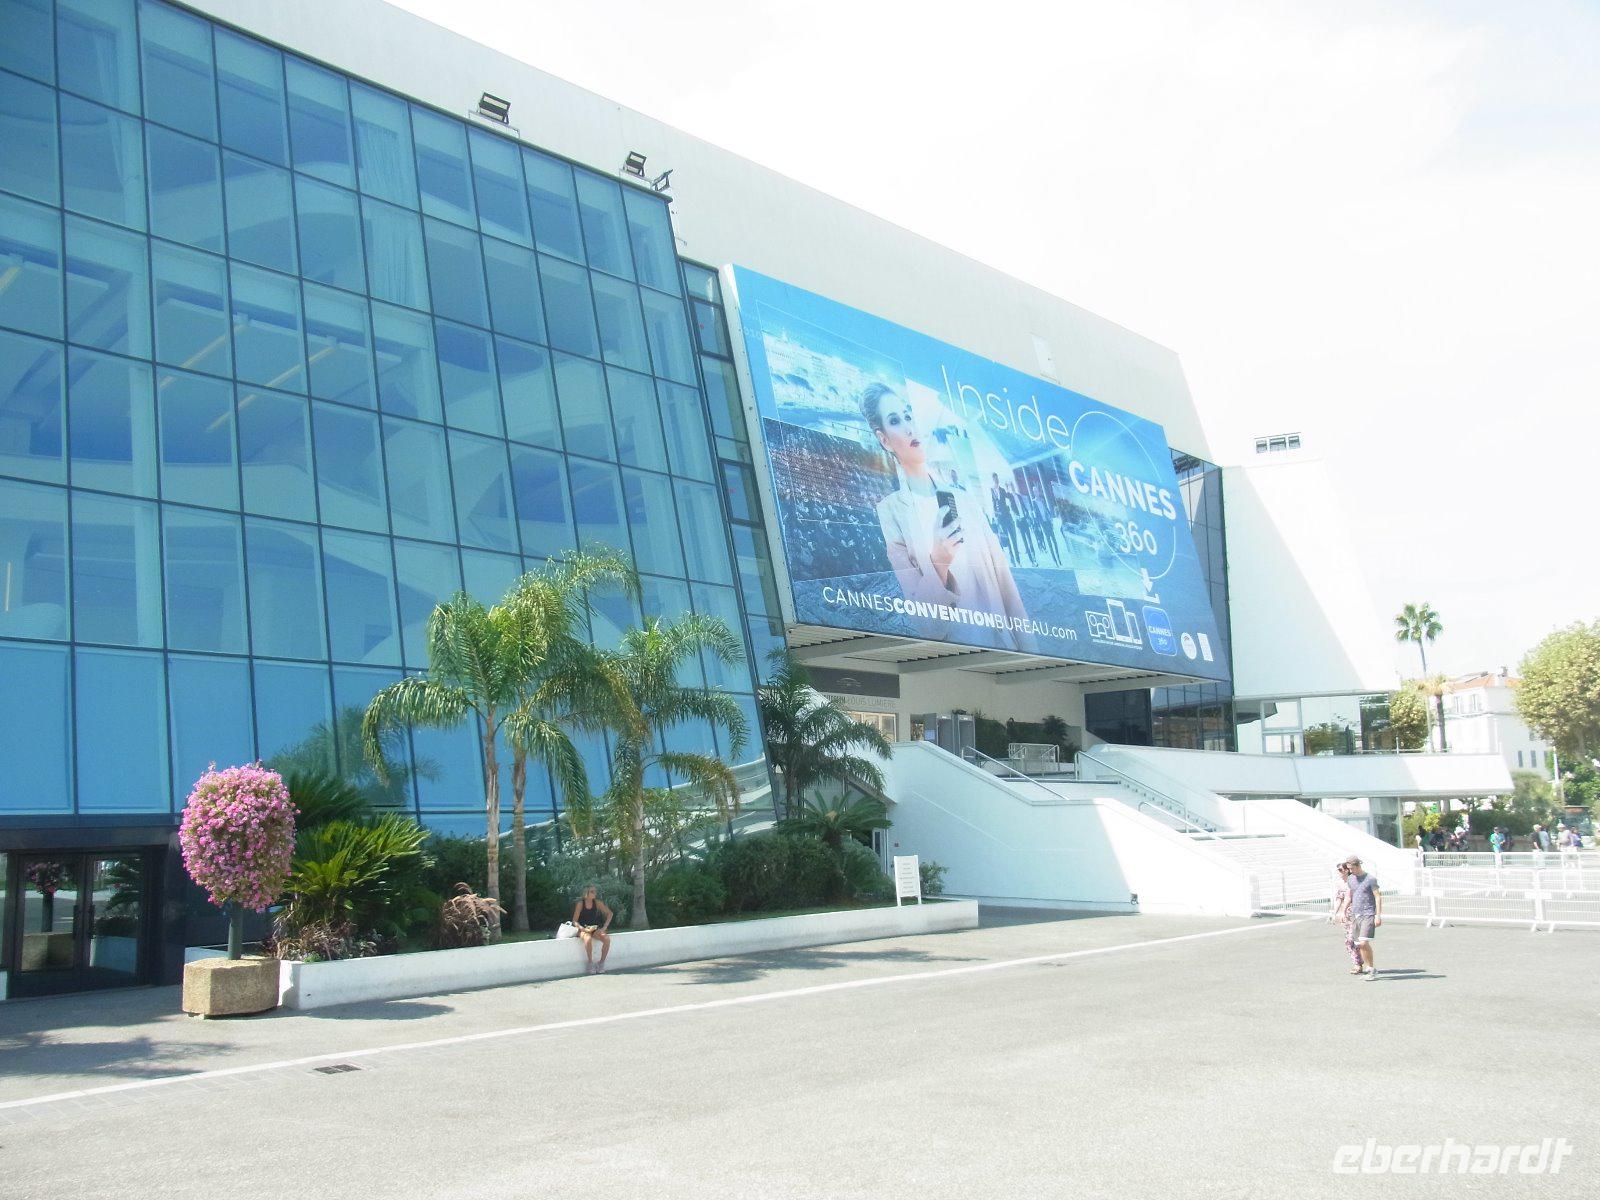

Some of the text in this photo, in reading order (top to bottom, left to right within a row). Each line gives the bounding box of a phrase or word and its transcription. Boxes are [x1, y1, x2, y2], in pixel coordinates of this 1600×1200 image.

[941, 364, 1070, 450] Inside
[1068, 460, 1177, 521] CANNES
[1115, 520, 1158, 556] 360
